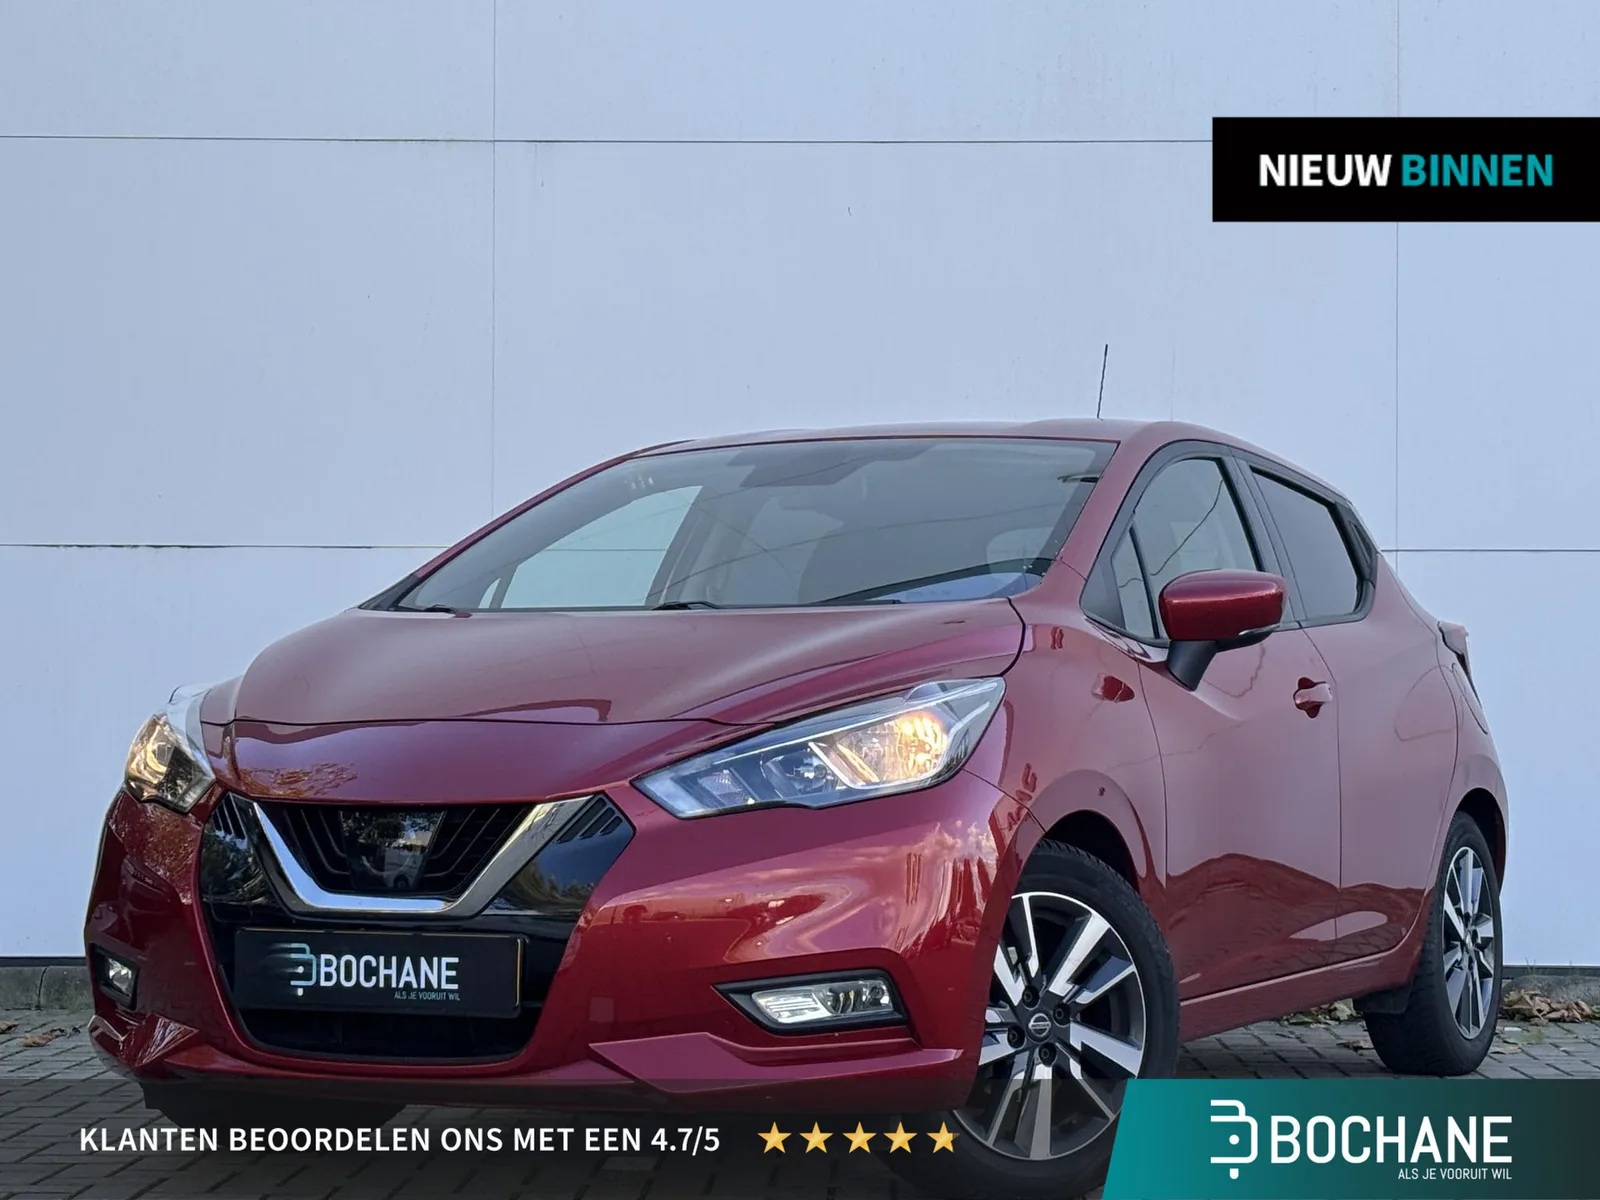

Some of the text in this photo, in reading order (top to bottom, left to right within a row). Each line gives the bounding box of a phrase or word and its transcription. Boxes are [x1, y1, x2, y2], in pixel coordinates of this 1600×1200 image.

[319, 953, 460, 990] BOCHANE
[394, 990, 460, 1001] ALS JE VOORUIT WIL
